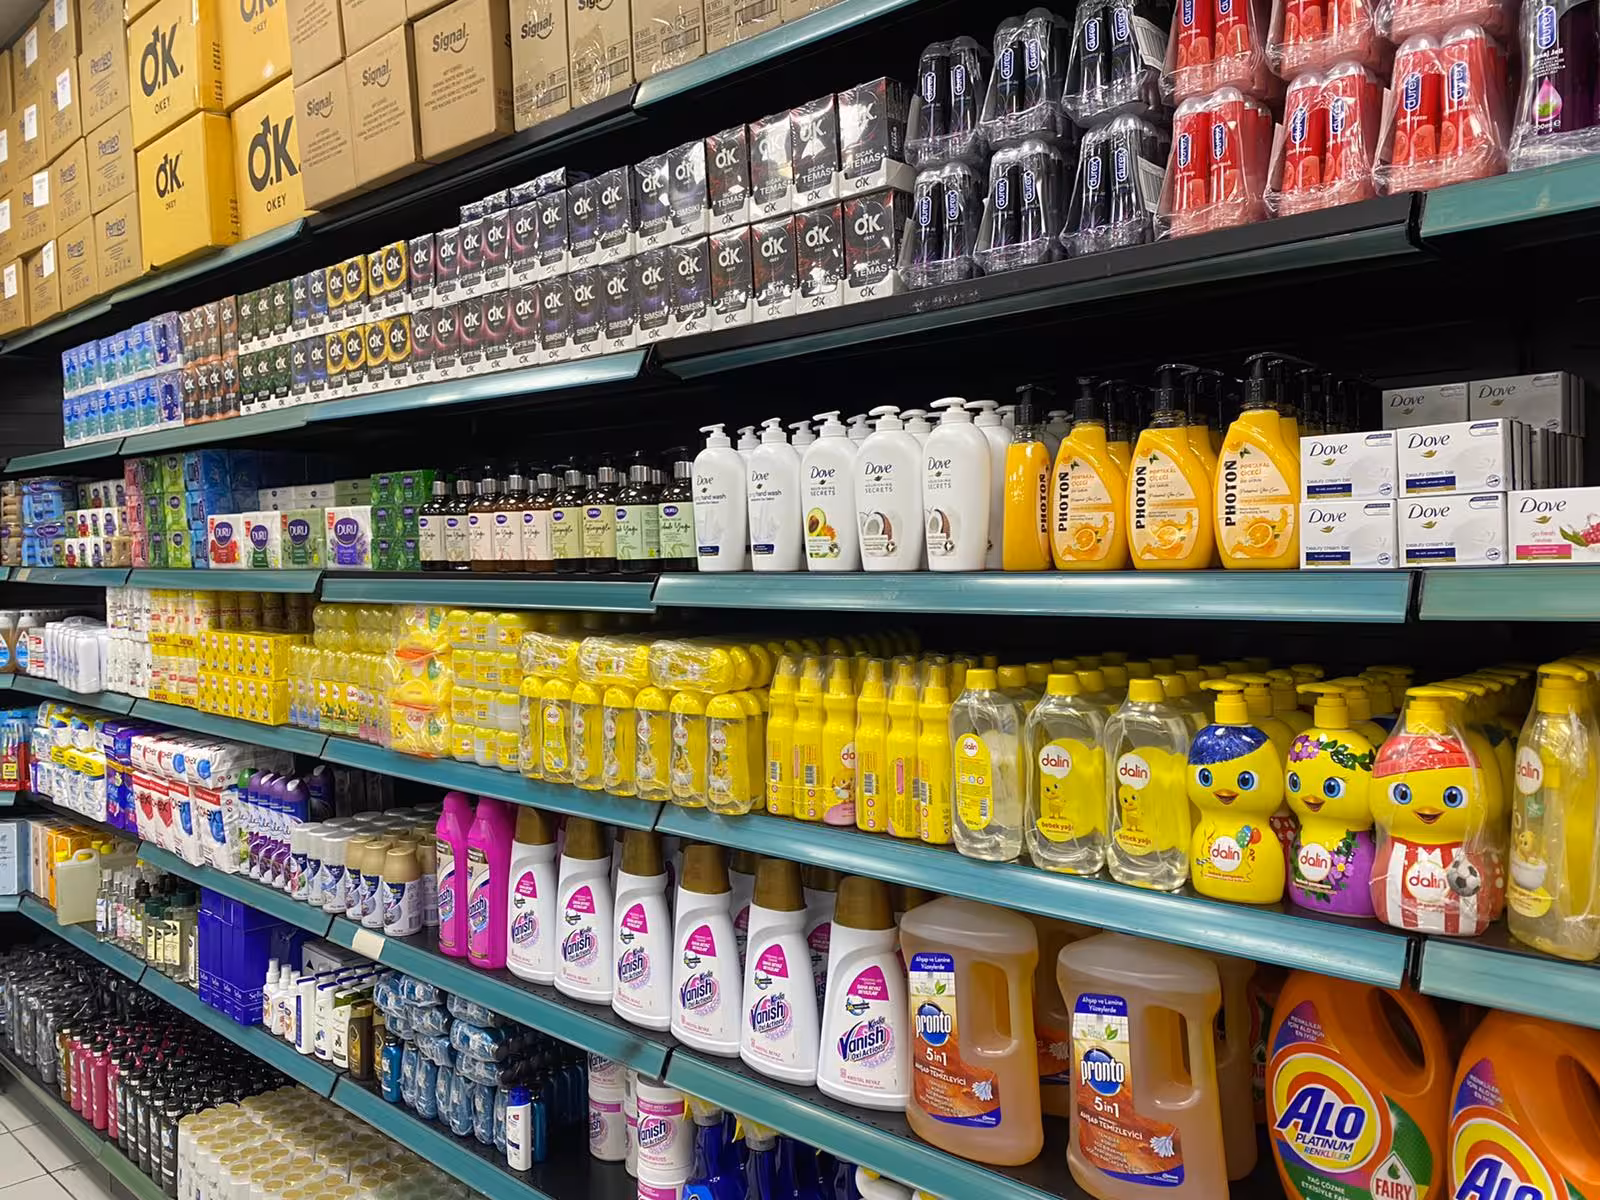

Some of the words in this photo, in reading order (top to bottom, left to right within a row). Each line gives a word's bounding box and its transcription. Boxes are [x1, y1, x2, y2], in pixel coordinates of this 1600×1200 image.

[520, 13, 554, 40] Signal
[1539, 9, 1554, 45] durex
[432, 22, 469, 53] Signal
[362, 59, 391, 87] Signal
[1405, 75, 1419, 109] durex
[154, 96, 172, 114] OKEY
[306, 92, 333, 118] Signal
[851, 154, 881, 168] TEMAS
[802, 169, 831, 183] TEMAS
[266, 194, 287, 213] OKEY
[855, 264, 887, 278] TEMAS
[1479, 385, 1516, 399] Dove
[1390, 394, 1424, 408] Dove
[1309, 442, 1348, 457] Dove
[1408, 433, 1450, 449] Dove
[811, 466, 835, 479] Dove
[865, 462, 892, 475] Dove
[928, 457, 951, 471] Dove
[697, 475, 713, 486] Dove
[752, 471, 769, 481] Dove
[1058, 472, 1069, 531] PHOTON
[1136, 466, 1147, 529] PHOTON
[1225, 460, 1237, 526] PHOTON
[1039, 474, 1047, 533] PHOTON
[1408, 503, 1450, 520] Dove
[1520, 497, 1567, 513] Dove
[1309, 509, 1347, 524] Dove
[216, 527, 231, 538] DURU
[252, 530, 267, 541] DURU
[290, 525, 308, 536] DURU
[337, 524, 357, 535] DURU
[964, 742, 977, 751] dalin
[1041, 755, 1069, 768] dalin
[1517, 759, 1540, 781] dalin
[1120, 763, 1147, 779] dalin
[1212, 844, 1240, 860] dalin
[1301, 852, 1328, 869] dalin
[1409, 872, 1448, 889] dalin
[512, 918, 533, 944] Vanish
[562, 934, 591, 961] Vanish
[618, 955, 643, 982] Vanish
[680, 979, 712, 1009] Vanish
[1082, 996, 1097, 1005] Ahşap
[1105, 998, 1123, 1006] Lamine
[750, 1004, 784, 1031] Vanish
[1089, 1005, 1117, 1013] Yüzeylerde
[916, 1013, 952, 1037] pronto
[840, 1028, 885, 1061] Vanish
[852, 1051, 863, 1060] Oxi
[1081, 1059, 1125, 1085] pronto
[1277, 1087, 1366, 1141] ALO
[1295, 1134, 1354, 1153] PLATINUM
[1304, 1147, 1350, 1161] RENKLİLER
[1307, 1176, 1320, 1185] YAĞ
[1321, 1180, 1345, 1195] ÇÖZME
[1375, 1177, 1412, 1200] FAIRY
